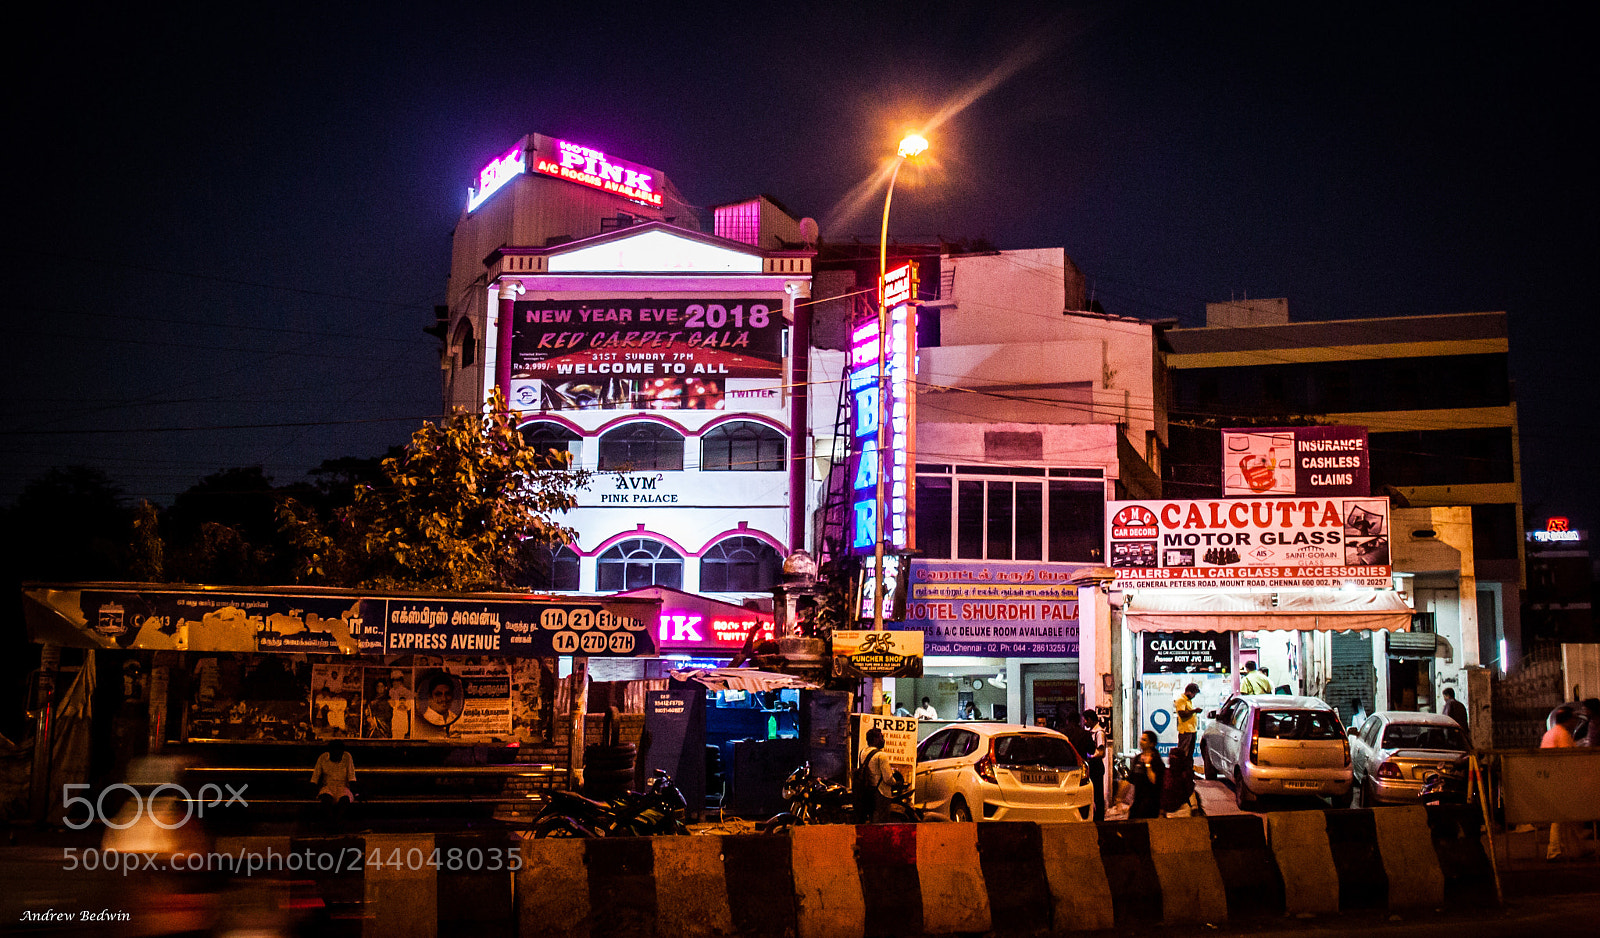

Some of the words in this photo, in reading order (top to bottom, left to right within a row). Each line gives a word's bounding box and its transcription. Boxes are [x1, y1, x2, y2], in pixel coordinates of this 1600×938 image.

[560, 141, 606, 162] HOTEL
[560, 150, 652, 192] PINK
[538, 161, 558, 174] A/C
[561, 167, 602, 186] ROOMS
[604, 181, 662, 204] AVAILABLE
[526, 310, 572, 323] NEW
[579, 308, 632, 322] YEAR
[639, 308, 678, 322] EVE
[685, 304, 770, 328] 2018
[537, 332, 585, 349] RED
[589, 331, 683, 348] CARPET
[687, 330, 750, 348] GALA
[556, 363, 654, 374] WELCOME
[662, 363, 686, 374] TO
[693, 363, 729, 374] ALL
[731, 389, 775, 398] TWITTER
[1298, 439, 1363, 452] INSURANCE
[854, 387, 879, 548] BAR
[1302, 456, 1360, 468] CASHLESS
[1311, 474, 1353, 486] CLAIMS
[601, 494, 629, 503] PINK
[633, 494, 678, 503] PALACE
[1161, 500, 1344, 529] CALCUTTA
[1114, 528, 1128, 536] CAR
[1129, 527, 1156, 536] DECORS
[1164, 532, 1251, 546] MOTOR
[1260, 531, 1341, 545] GLASS
[1115, 569, 1170, 578] DEALERS
[1181, 569, 1204, 578] ALL
[1208, 569, 1234, 578] CAR
[1238, 568, 1279, 577] GLASS
[1283, 568, 1293, 577] &
[1297, 567, 1387, 576] ACCESSORIES
[1136, 580, 1168, 588] GENERAL
[1170, 580, 1196, 588] PETERS
[1197, 580, 1218, 588] ROAD,
[1219, 580, 1245, 588] MOUNT
[1247, 580, 1268, 588] ROAD,
[1332, 579, 1342, 587] Ph.
[905, 603, 957, 620] HOTEL
[962, 603, 1035, 620] SHURDHI
[545, 613, 563, 626] 11A
[574, 613, 590, 626] 21
[600, 613, 618, 627] E18
[936, 627, 941, 636] &
[960, 627, 991, 636] DELUXE
[993, 627, 1017, 636] ROOM
[1019, 627, 1063, 636] AVAILABLE
[1065, 627, 1079, 636] FOR
[390, 633, 447, 649] EXPRESS
[450, 634, 500, 650] AVENUE
[557, 636, 575, 649] 1A
[583, 636, 605, 648] 27D
[611, 637, 633, 649] 27H
[953, 644, 982, 652] Chennai
[1013, 644, 1026, 652] 044
[1150, 640, 1217, 650] CALCUTTA
[873, 718, 916, 732] FREE
